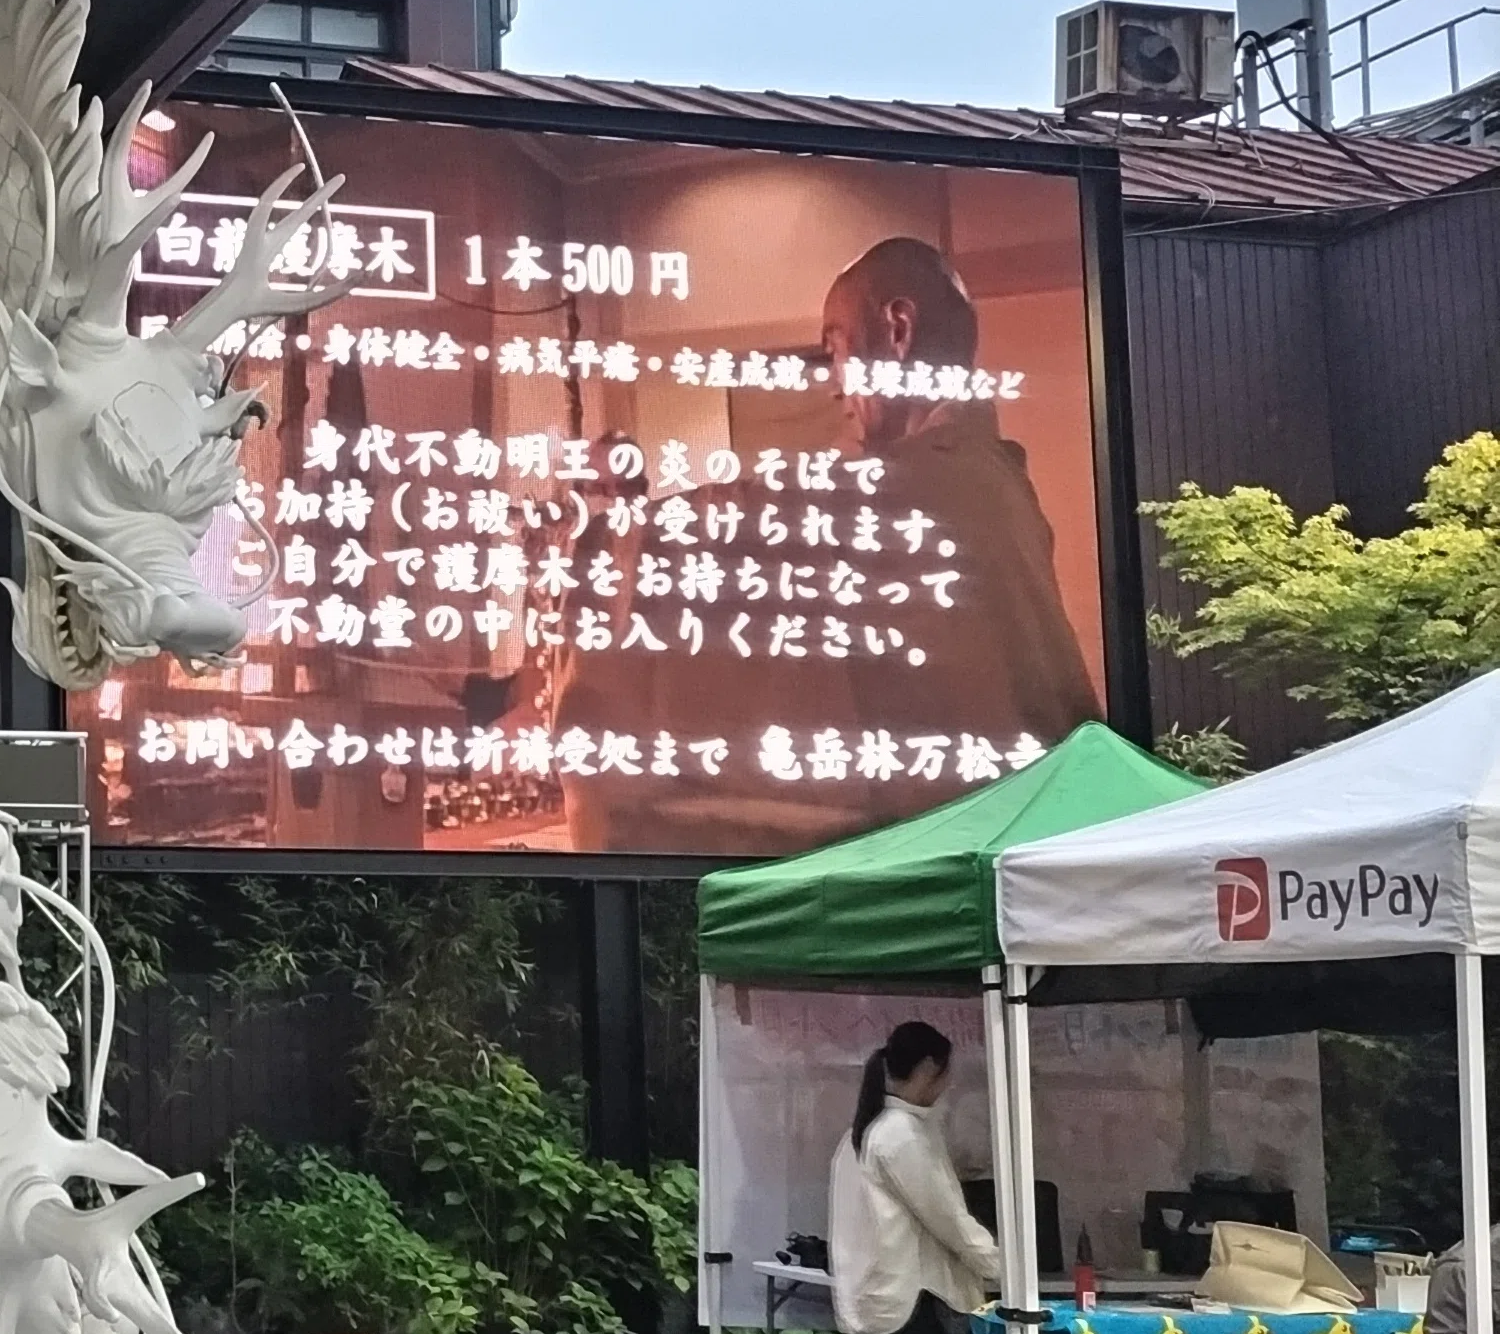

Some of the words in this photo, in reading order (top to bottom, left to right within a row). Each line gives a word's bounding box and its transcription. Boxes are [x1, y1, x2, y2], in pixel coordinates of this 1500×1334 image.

[302, 418, 886, 496] 身代不動明王の炎のそばで
[231, 535, 962, 609] ご自分で護摩木をお持ちになって
[265, 592, 927, 667] 不動堂の中にお入りください。
[1278, 863, 1440, 932] PayPay
